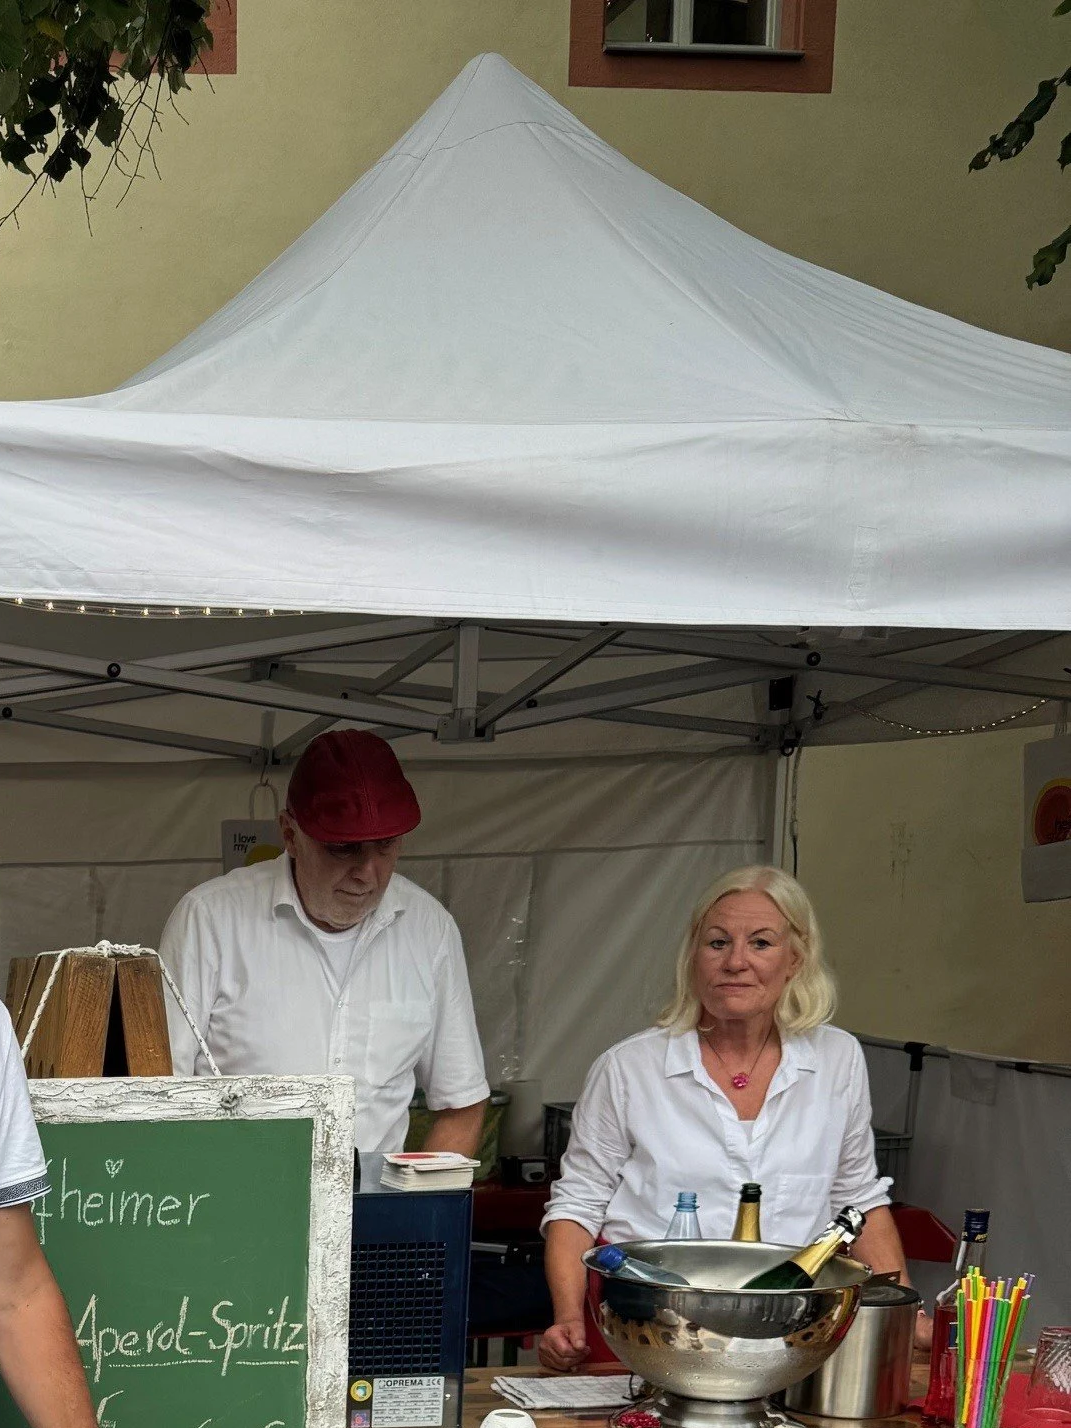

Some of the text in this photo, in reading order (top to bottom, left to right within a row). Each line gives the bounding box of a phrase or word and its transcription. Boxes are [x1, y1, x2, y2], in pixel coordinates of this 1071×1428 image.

[233, 844, 248, 853] my
[238, 833, 257, 843] love
[31, 1157, 210, 1245] fheimer
[75, 1294, 307, 1383] Aperol-Spritz
